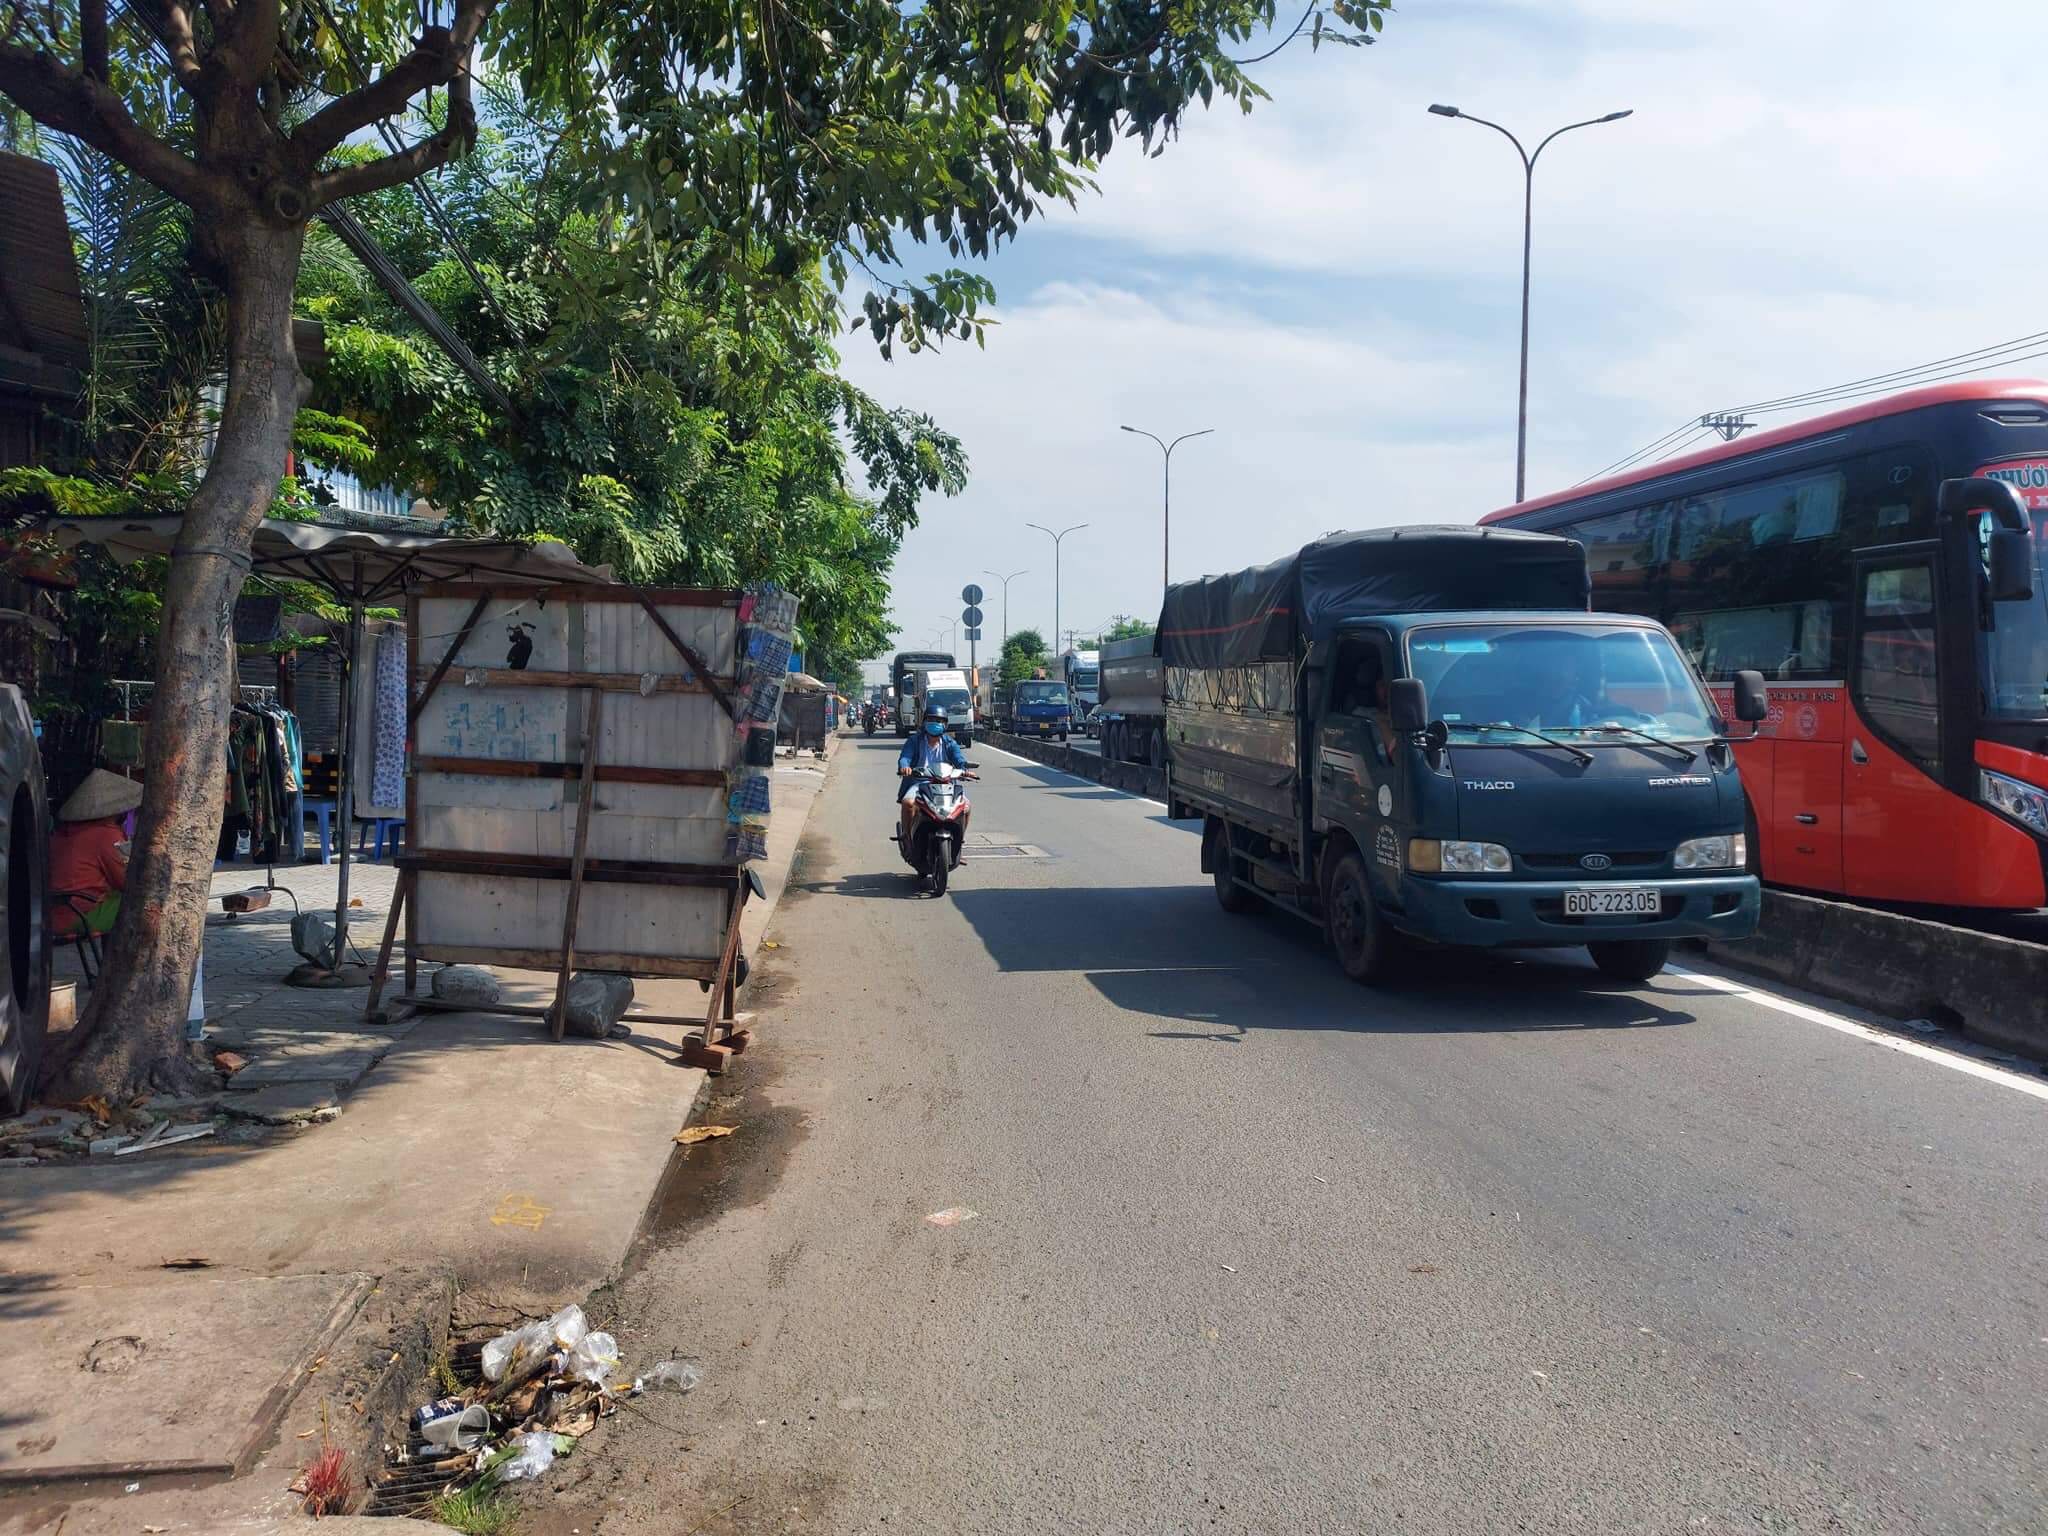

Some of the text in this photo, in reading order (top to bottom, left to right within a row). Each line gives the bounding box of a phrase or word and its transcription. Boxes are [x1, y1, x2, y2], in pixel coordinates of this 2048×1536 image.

[1463, 781, 1516, 791] THACO
[1584, 856, 1608, 867] KIA
[1568, 892, 1657, 913] 60C-223.05
